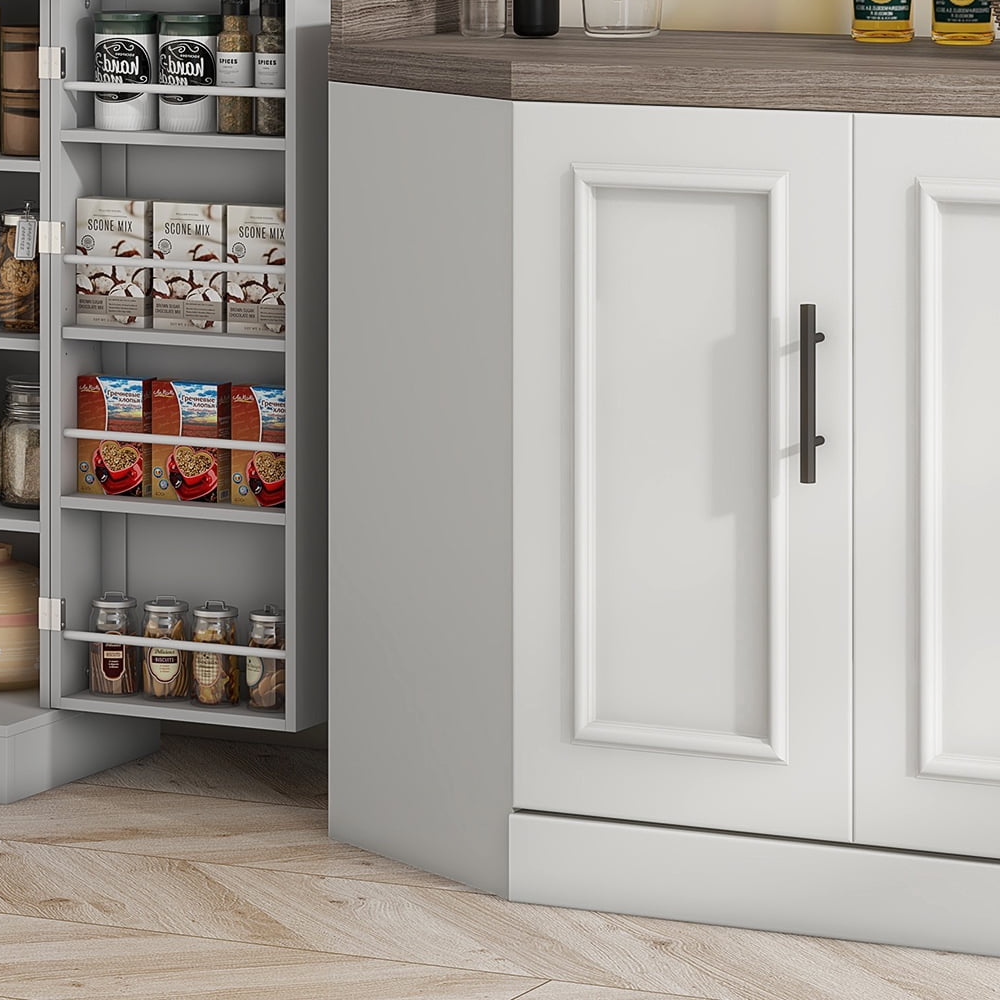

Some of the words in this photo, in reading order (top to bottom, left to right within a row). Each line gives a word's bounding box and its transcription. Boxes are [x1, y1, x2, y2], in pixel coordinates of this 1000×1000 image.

[88, 219, 114, 232] SCONE
[118, 220, 132, 232] MIX
[165, 223, 191, 236] SCONE
[195, 224, 210, 236] MIX
[239, 226, 265, 239] SCONE
[269, 227, 285, 240] MIX
[181, 395, 215, 403] Гречневые
